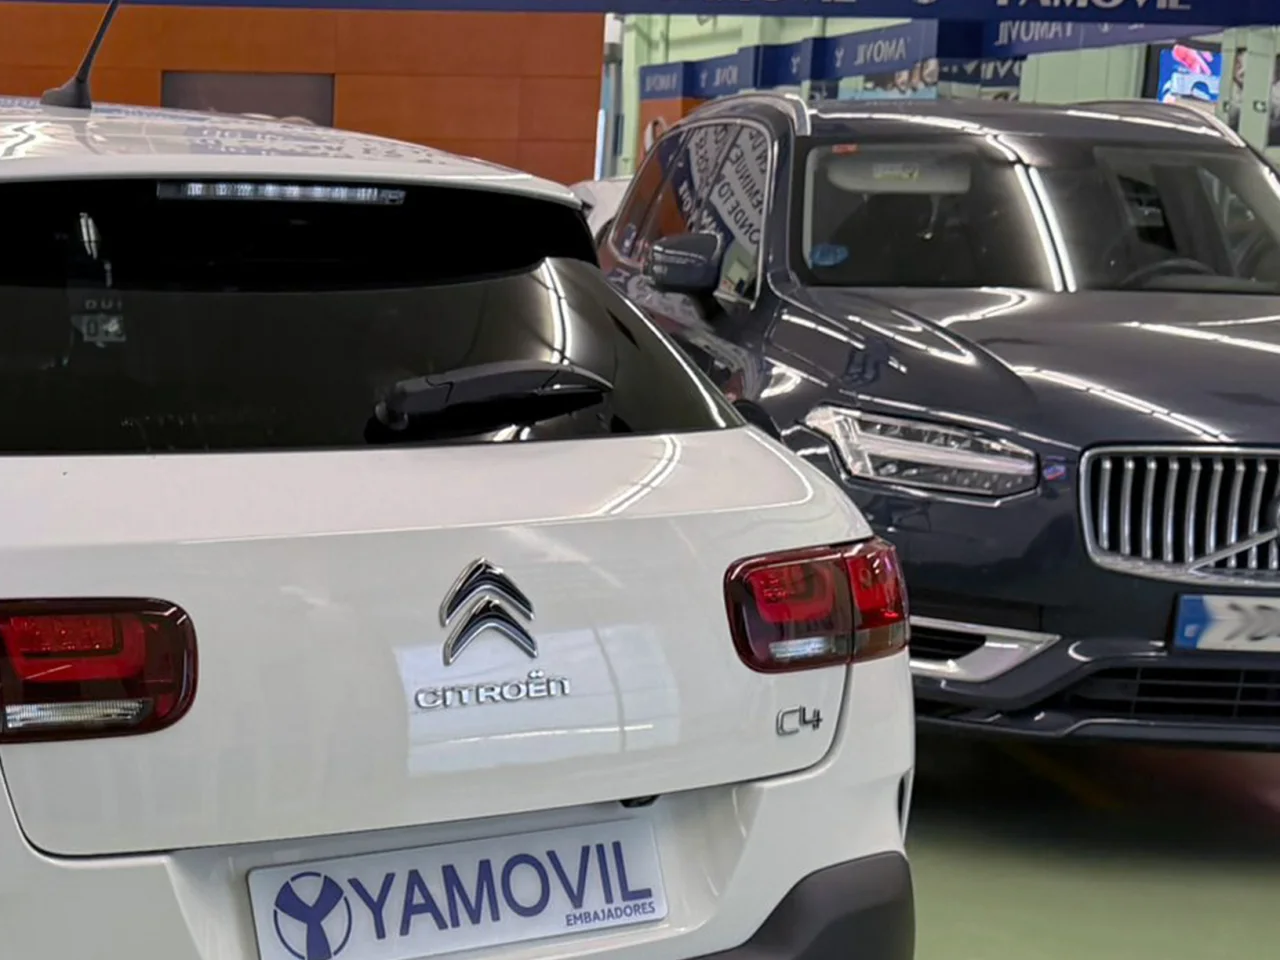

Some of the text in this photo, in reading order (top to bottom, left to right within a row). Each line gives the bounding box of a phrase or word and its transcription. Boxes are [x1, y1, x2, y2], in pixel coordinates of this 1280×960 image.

[775, 705, 823, 736] C4
[348, 841, 653, 940] YAMOVIL
[565, 901, 655, 926] EMBAJADORES
